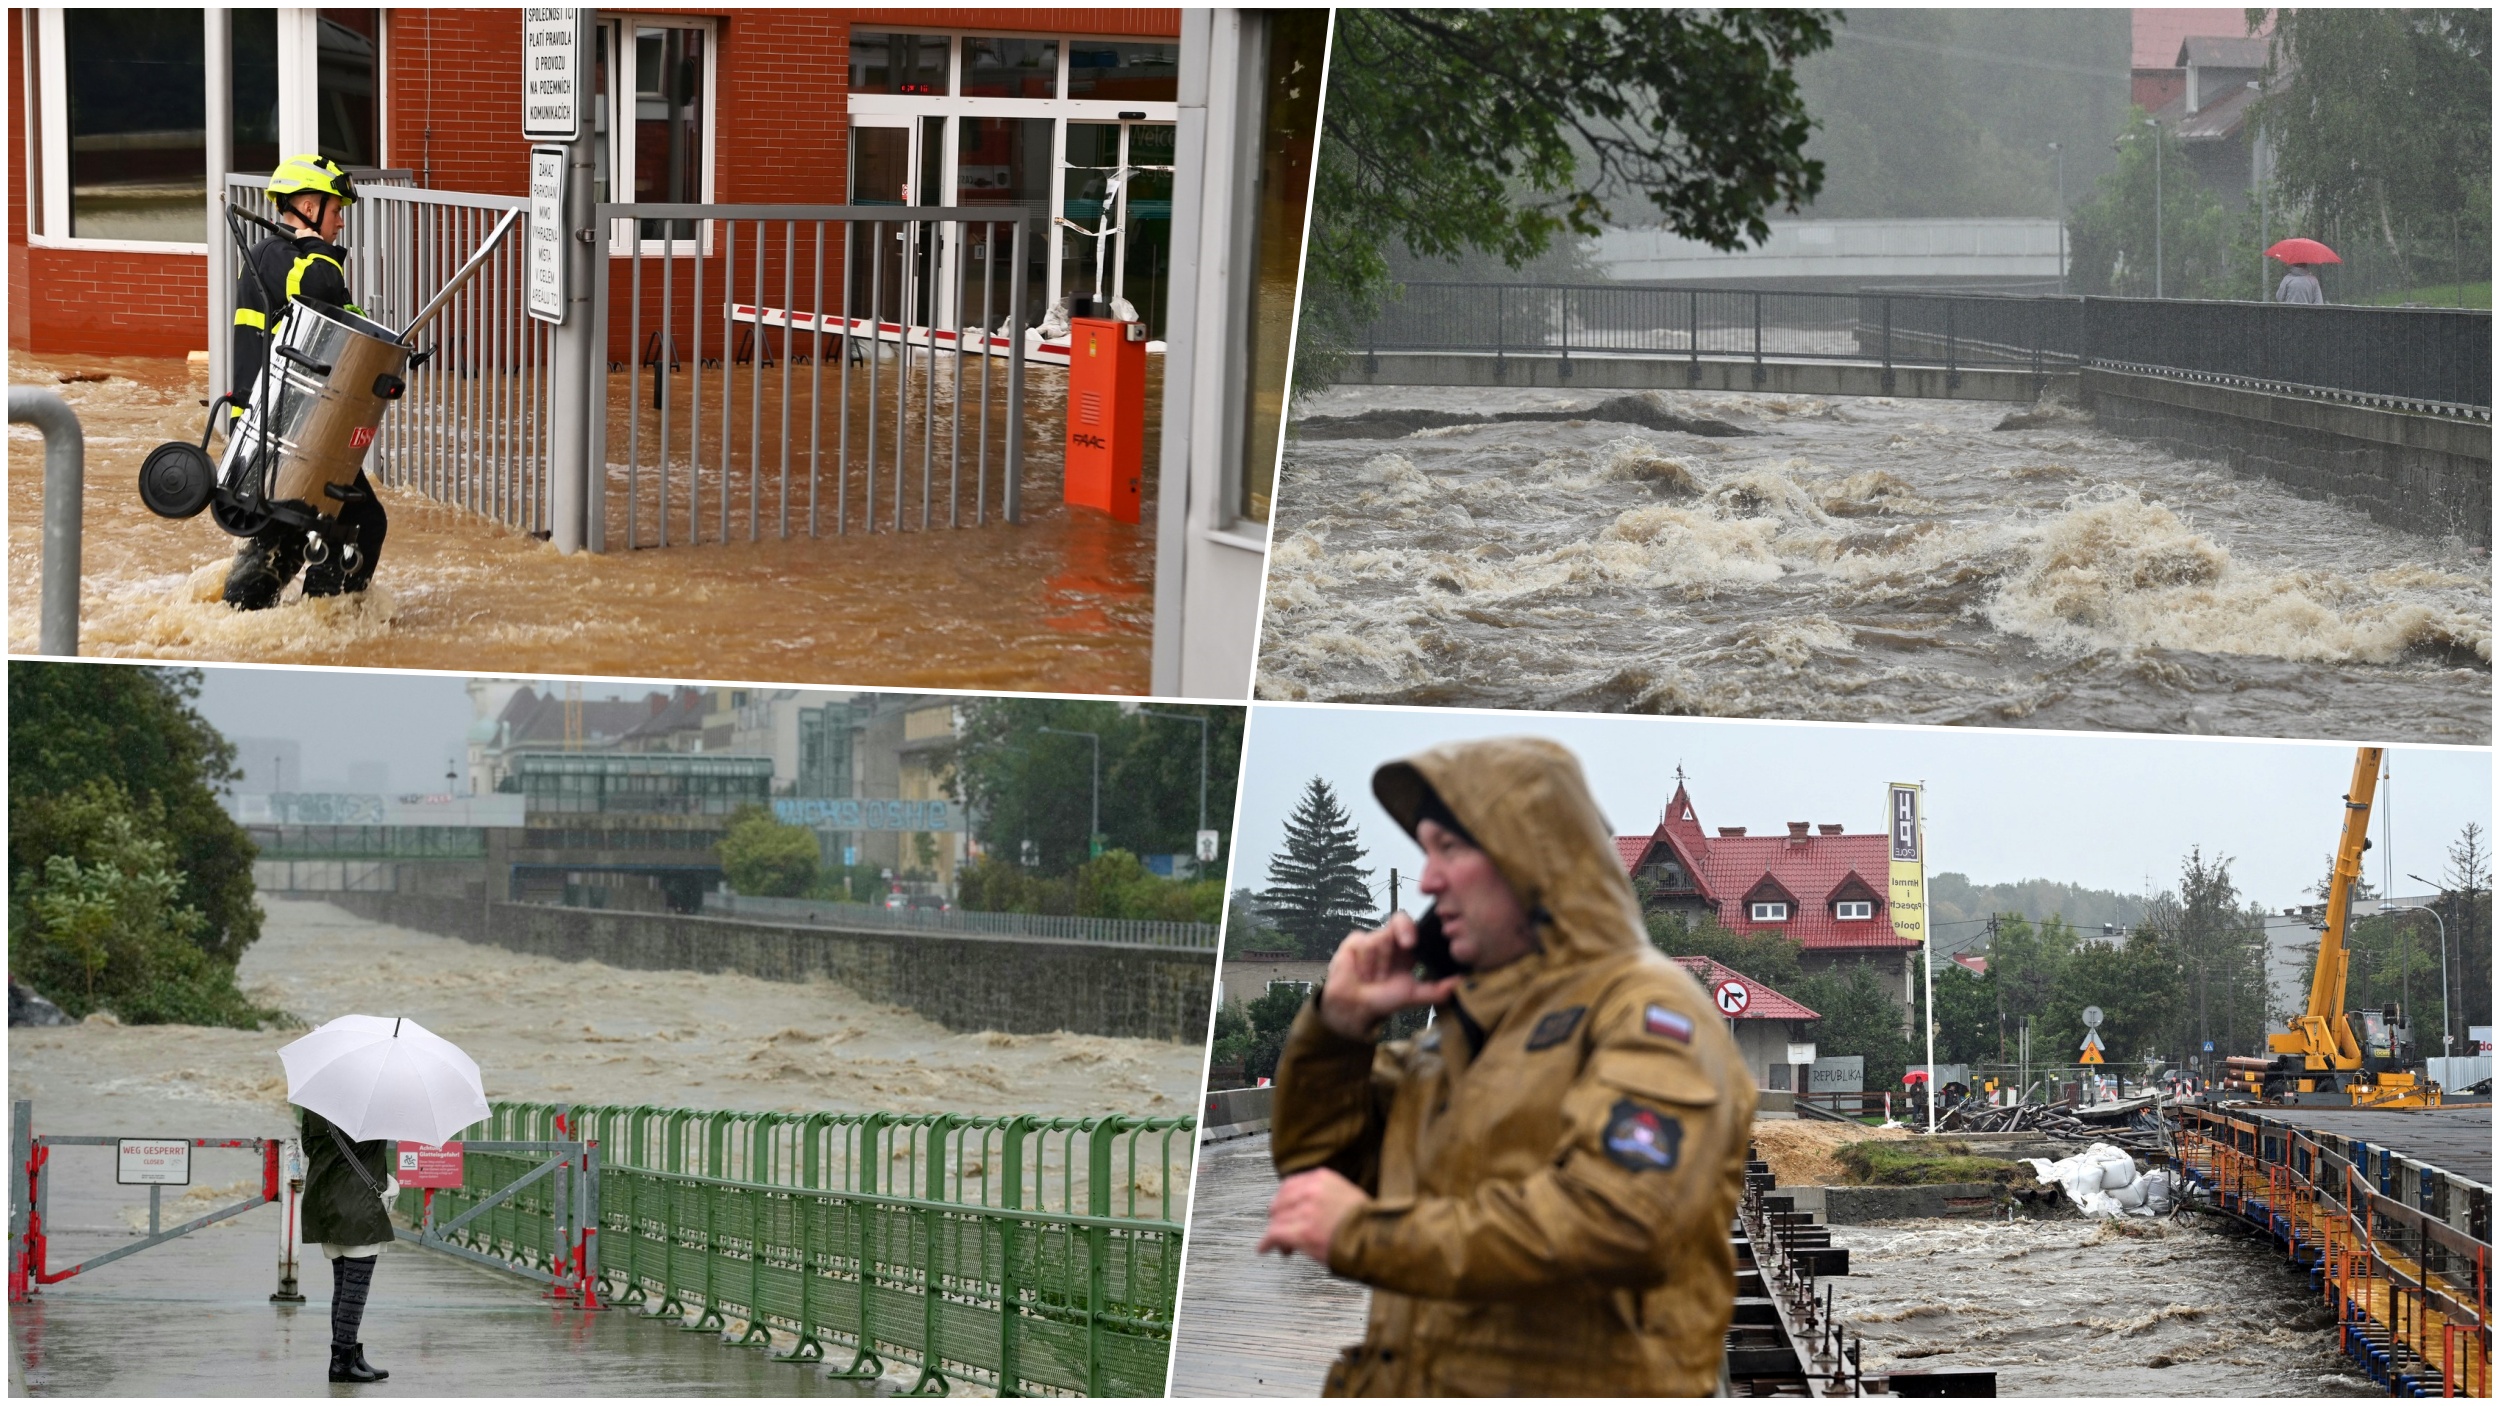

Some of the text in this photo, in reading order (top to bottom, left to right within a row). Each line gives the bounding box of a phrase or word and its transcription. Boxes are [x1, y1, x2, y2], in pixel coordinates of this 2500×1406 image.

[529, 29, 572, 47] PLATÍ PRAVIDLA
[535, 56, 566, 71] O PROVOZU
[530, 76, 571, 94] NA POZEMNÍCH
[530, 102, 571, 120] KOMUNIKACÍCH
[539, 160, 554, 177] ZÁKAZ
[534, 182, 558, 199] PARKOVÁNÍ
[539, 206, 551, 220] MIMO
[532, 225, 558, 242] VYHRAZENÁ
[540, 268, 555, 284] CELÉM
[1073, 434, 1106, 450] FAAC
[1812, 1069, 1863, 1082] REPUBLIKA
[123, 1146, 185, 1155] WEG GESPERRT
